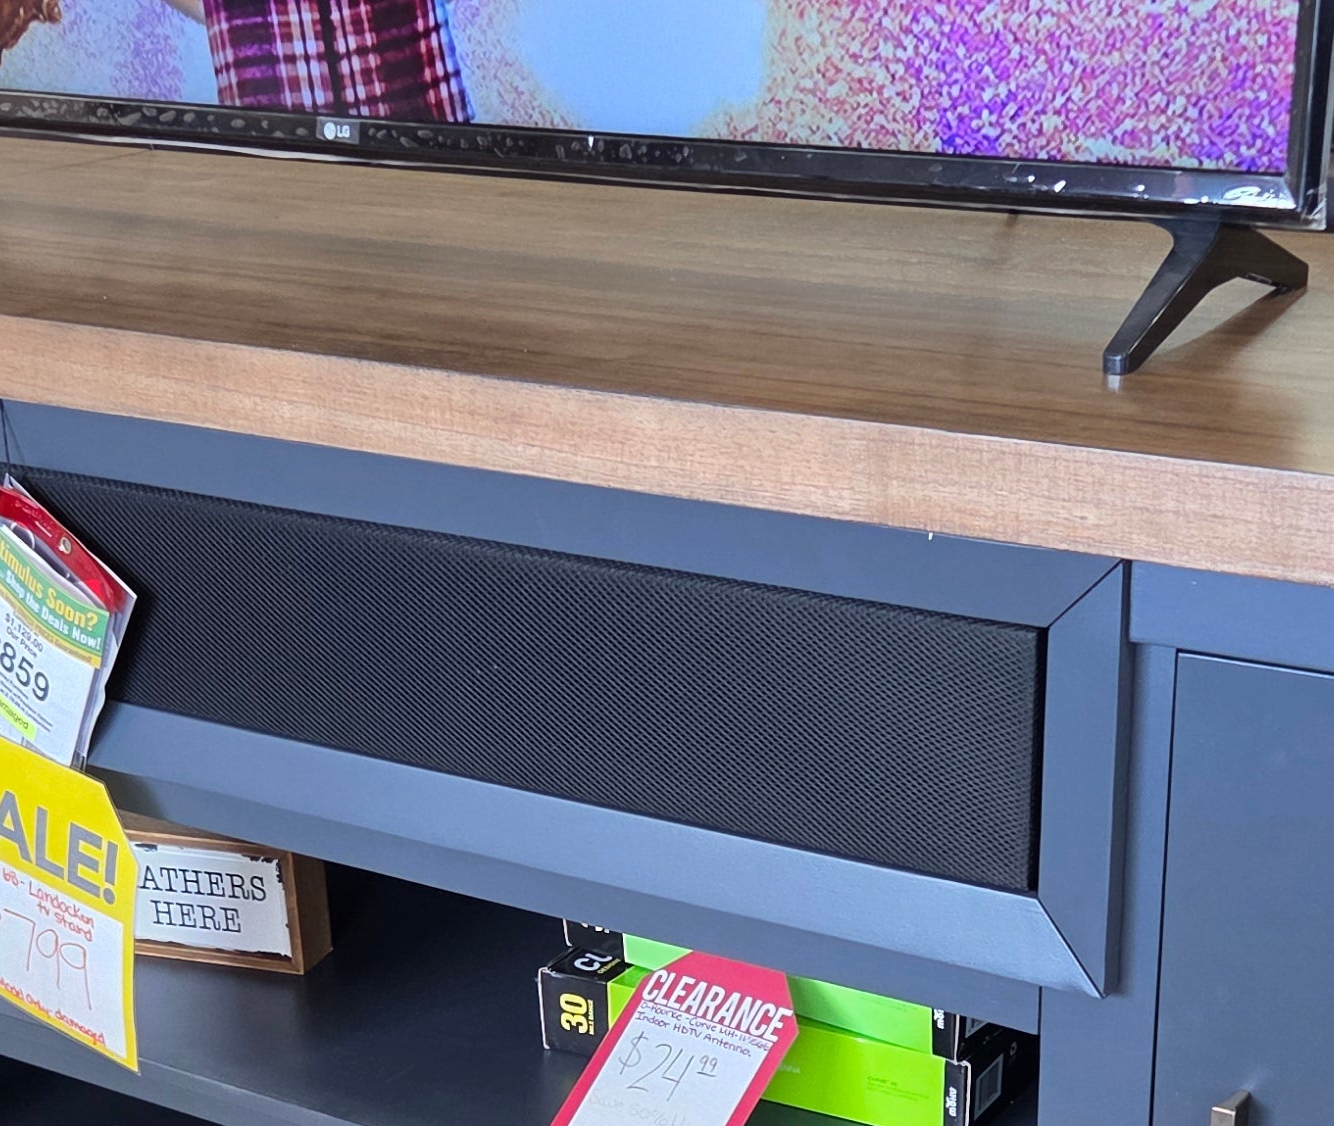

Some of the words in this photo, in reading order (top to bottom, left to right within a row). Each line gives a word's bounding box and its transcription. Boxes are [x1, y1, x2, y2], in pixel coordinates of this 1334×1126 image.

[5, 569, 26, 598] Shop
[41, 606, 69, 635] Deals
[72, 627, 101, 650] Now!
[46, 587, 98, 631] Soon?
[137, 865, 267, 902] ATHERS
[150, 899, 242, 933] HERE
[560, 993, 589, 1034] 30
[642, 969, 794, 1043] CLEARANCE
[673, 1021, 702, 1038] HDTV
